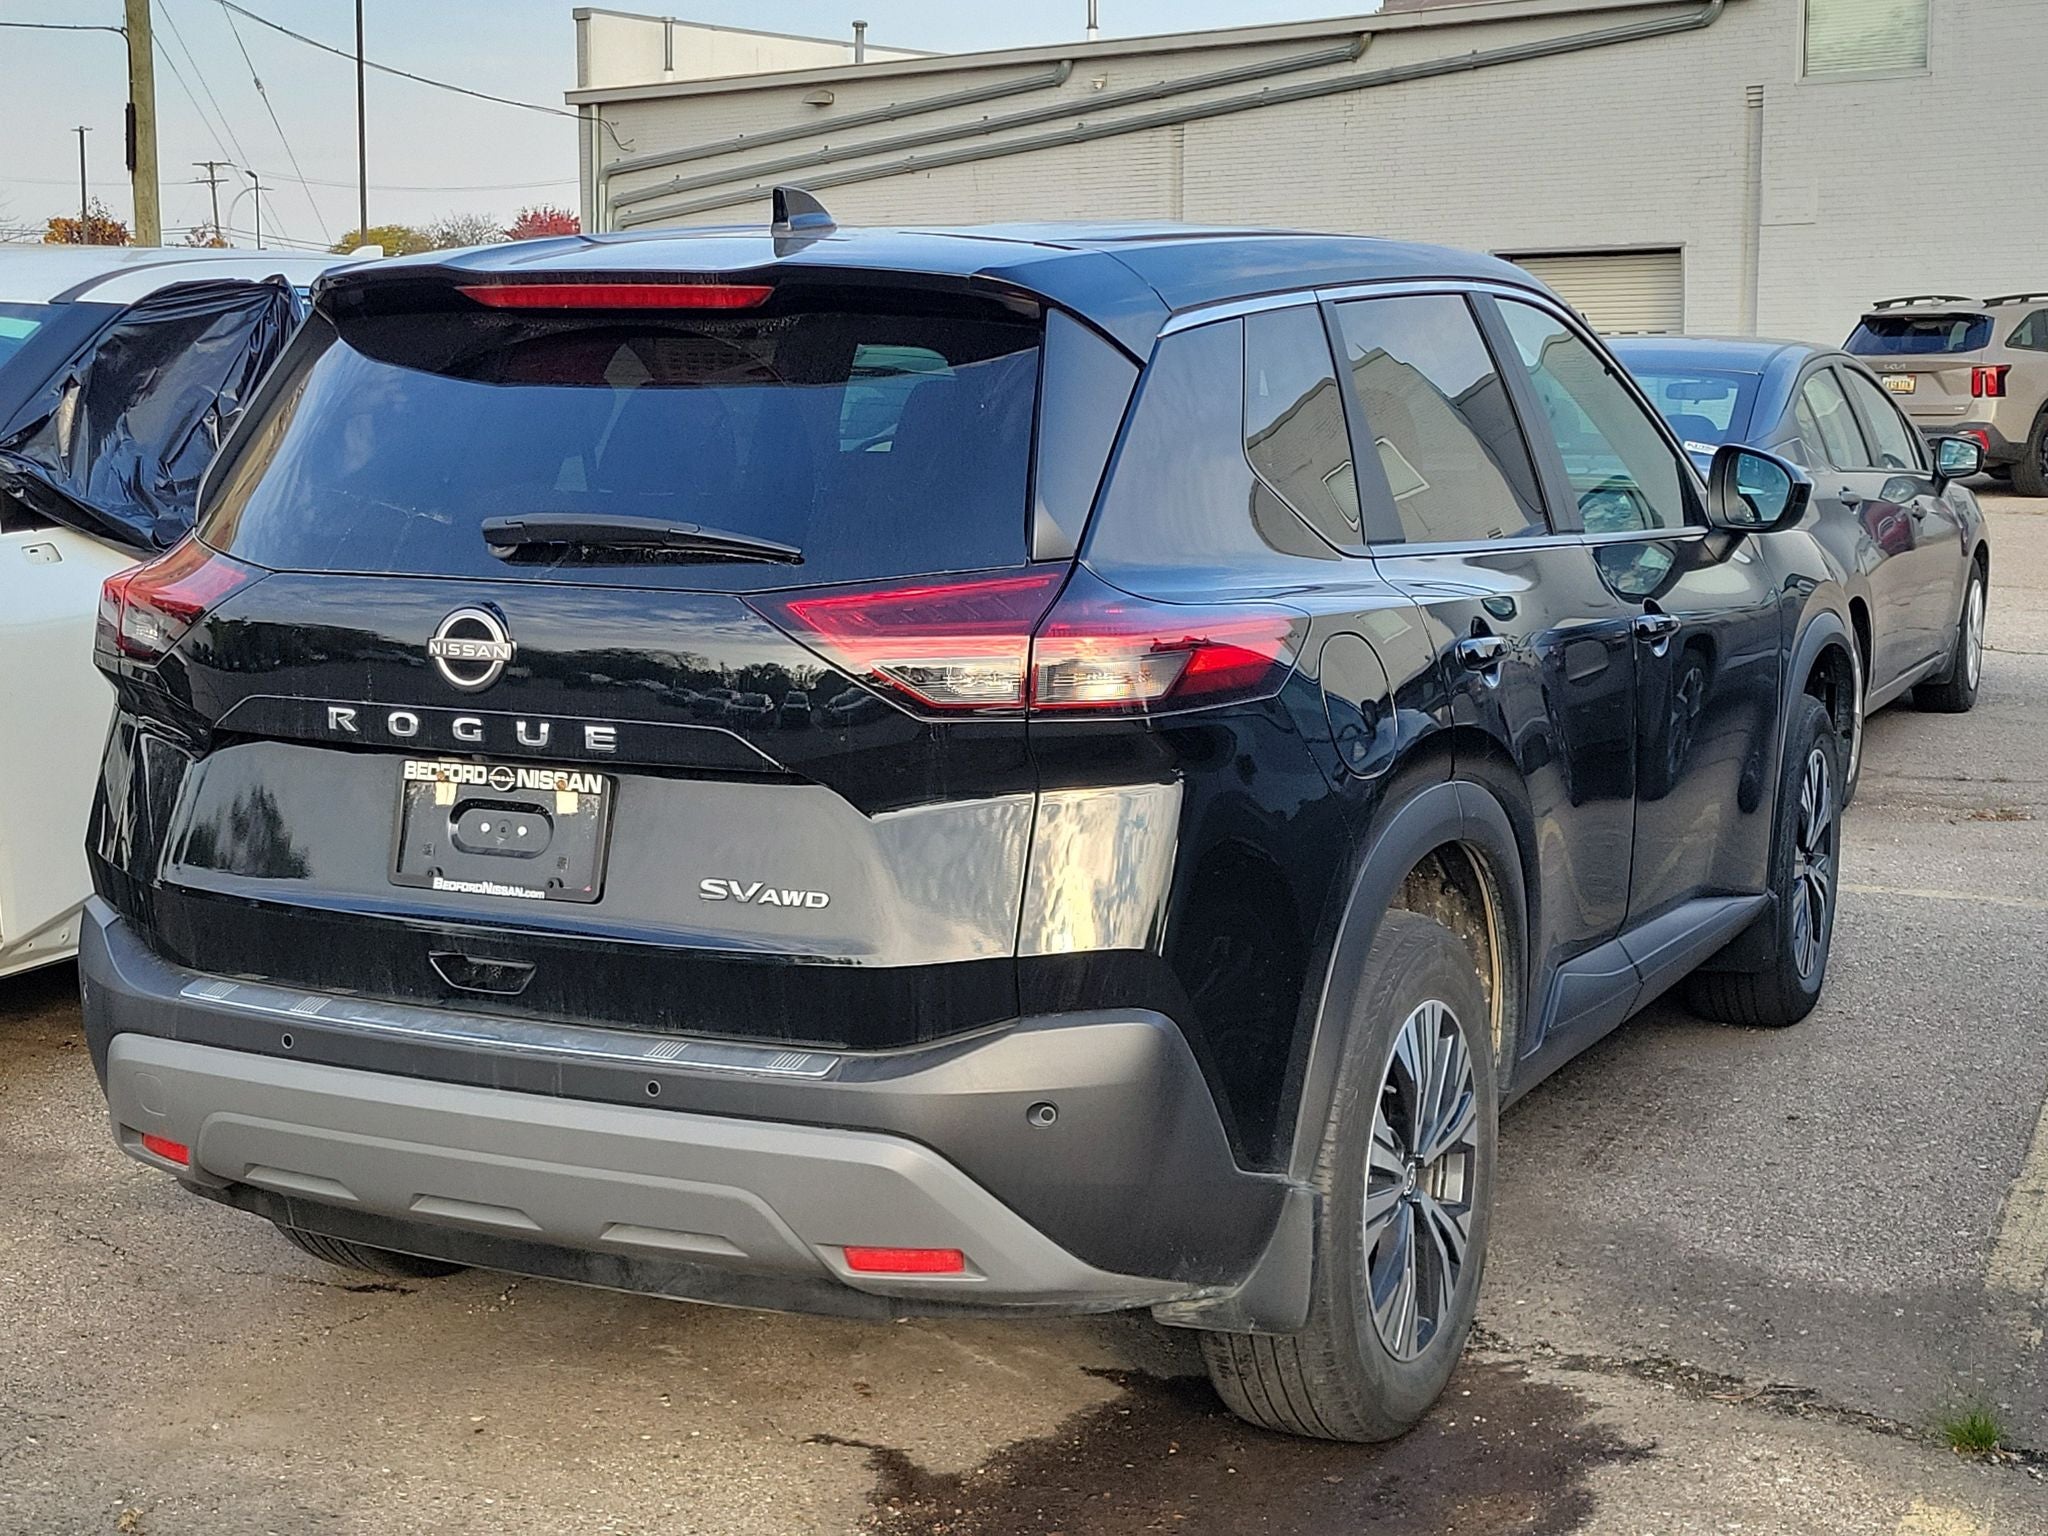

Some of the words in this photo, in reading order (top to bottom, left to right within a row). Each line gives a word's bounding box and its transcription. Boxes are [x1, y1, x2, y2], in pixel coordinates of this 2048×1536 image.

[429, 641, 509, 659] NISSAN
[327, 706, 618, 753] ROGUE
[404, 760, 487, 785] BEDFORD
[517, 768, 602, 794] NISSAN
[699, 878, 764, 903] SV
[757, 888, 830, 909] AWD
